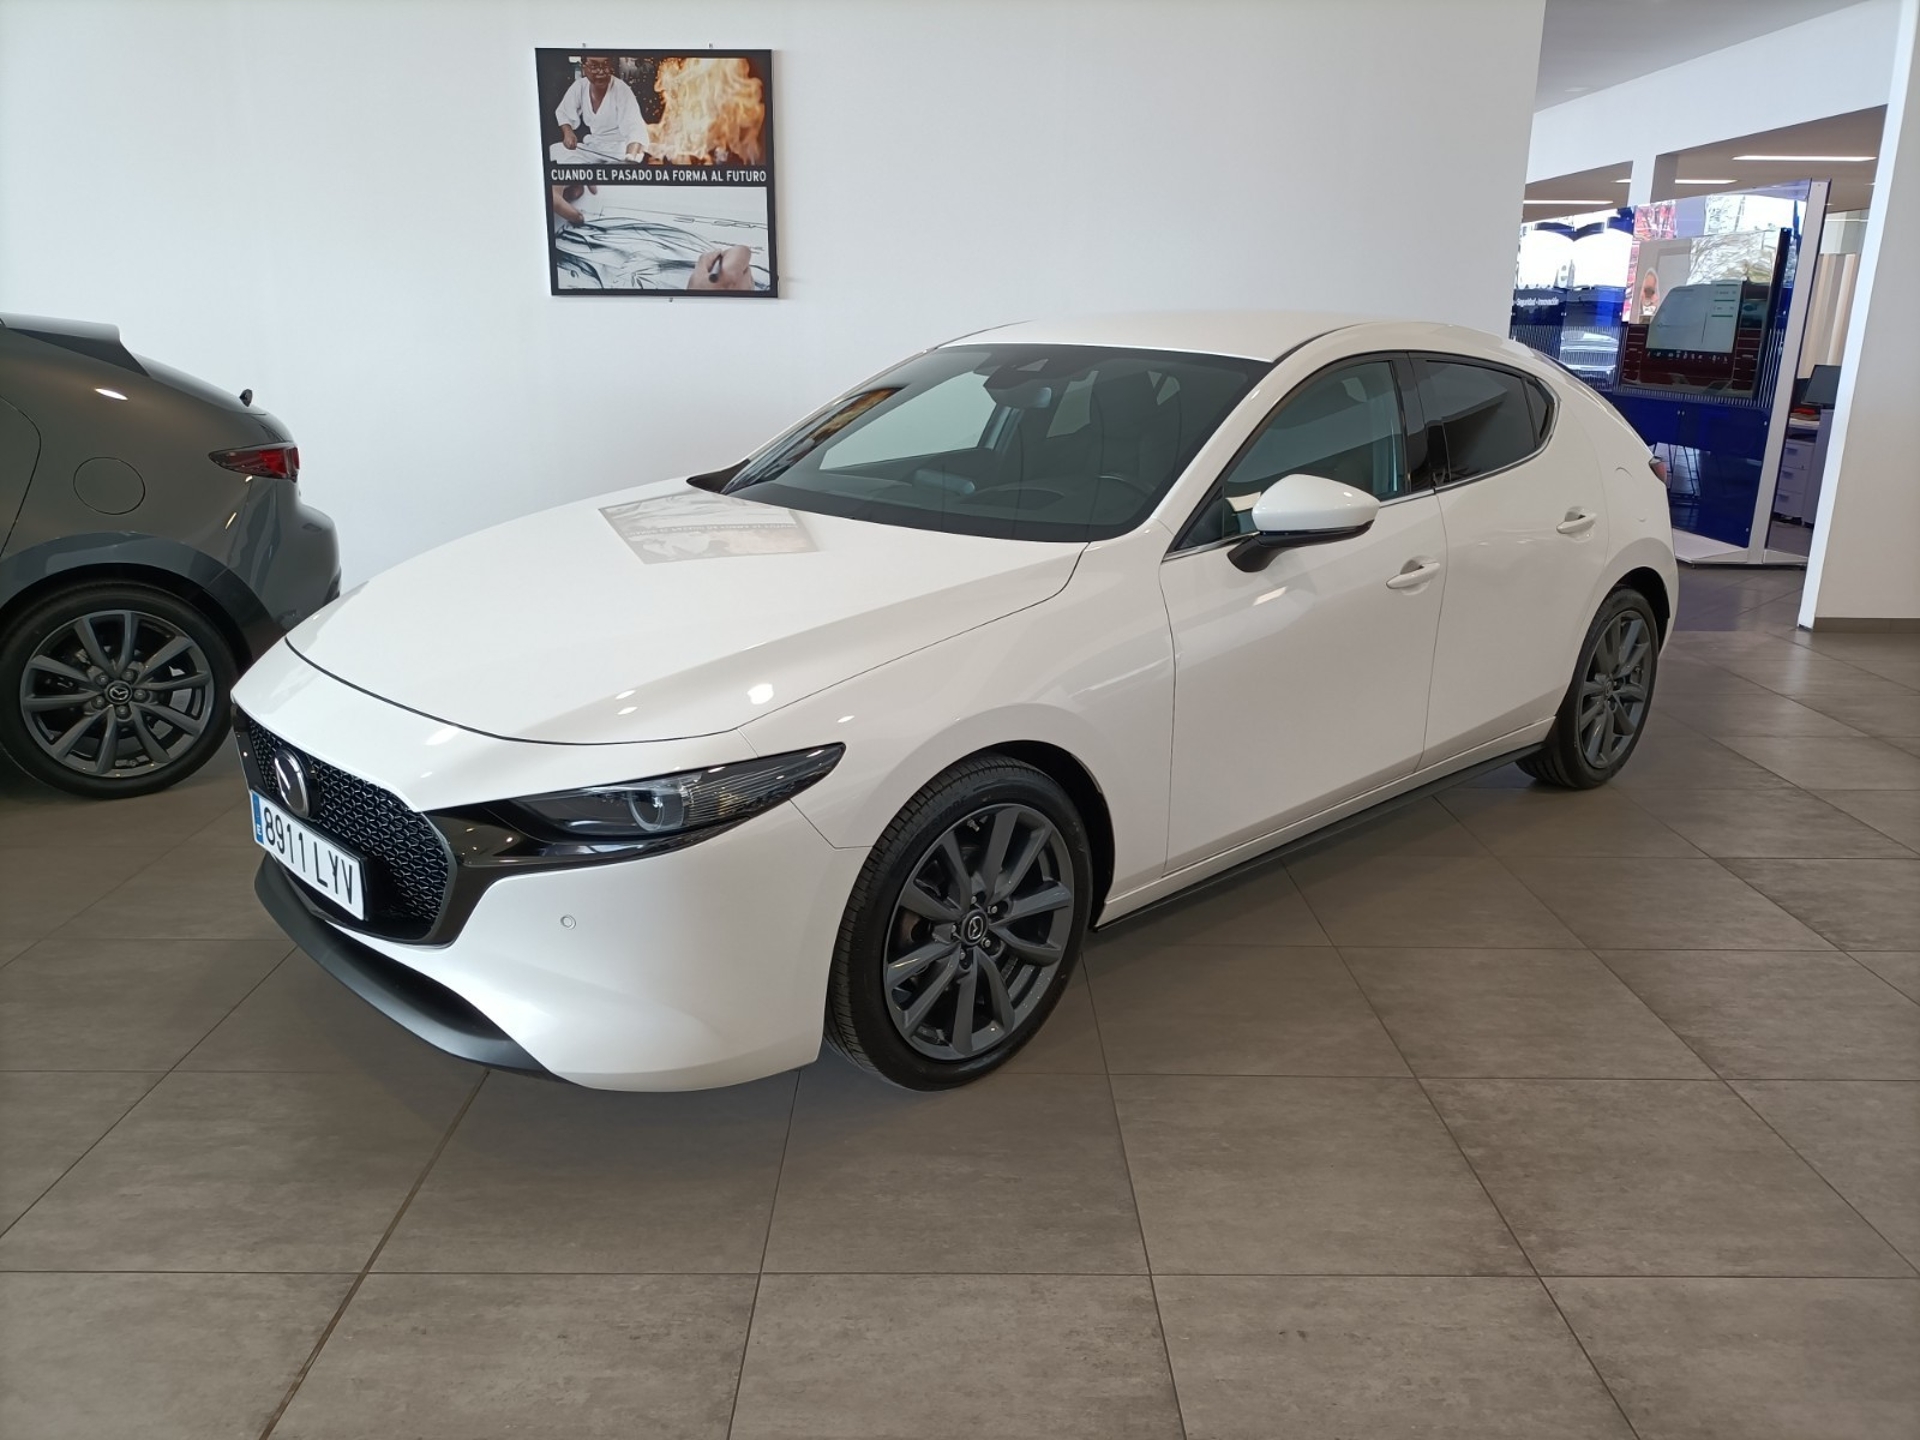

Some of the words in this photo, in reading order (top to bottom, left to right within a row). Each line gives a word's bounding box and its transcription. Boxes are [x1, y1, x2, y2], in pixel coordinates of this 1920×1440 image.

[551, 169, 594, 181] CUANDO
[596, 169, 609, 181] EL
[611, 169, 653, 181] PASADO
[655, 170, 669, 181] DA
[672, 170, 708, 182] FORMA
[711, 170, 723, 182] AL
[726, 170, 767, 182] FUTURO
[264, 807, 306, 873] 8911
[313, 841, 352, 905] LYV
